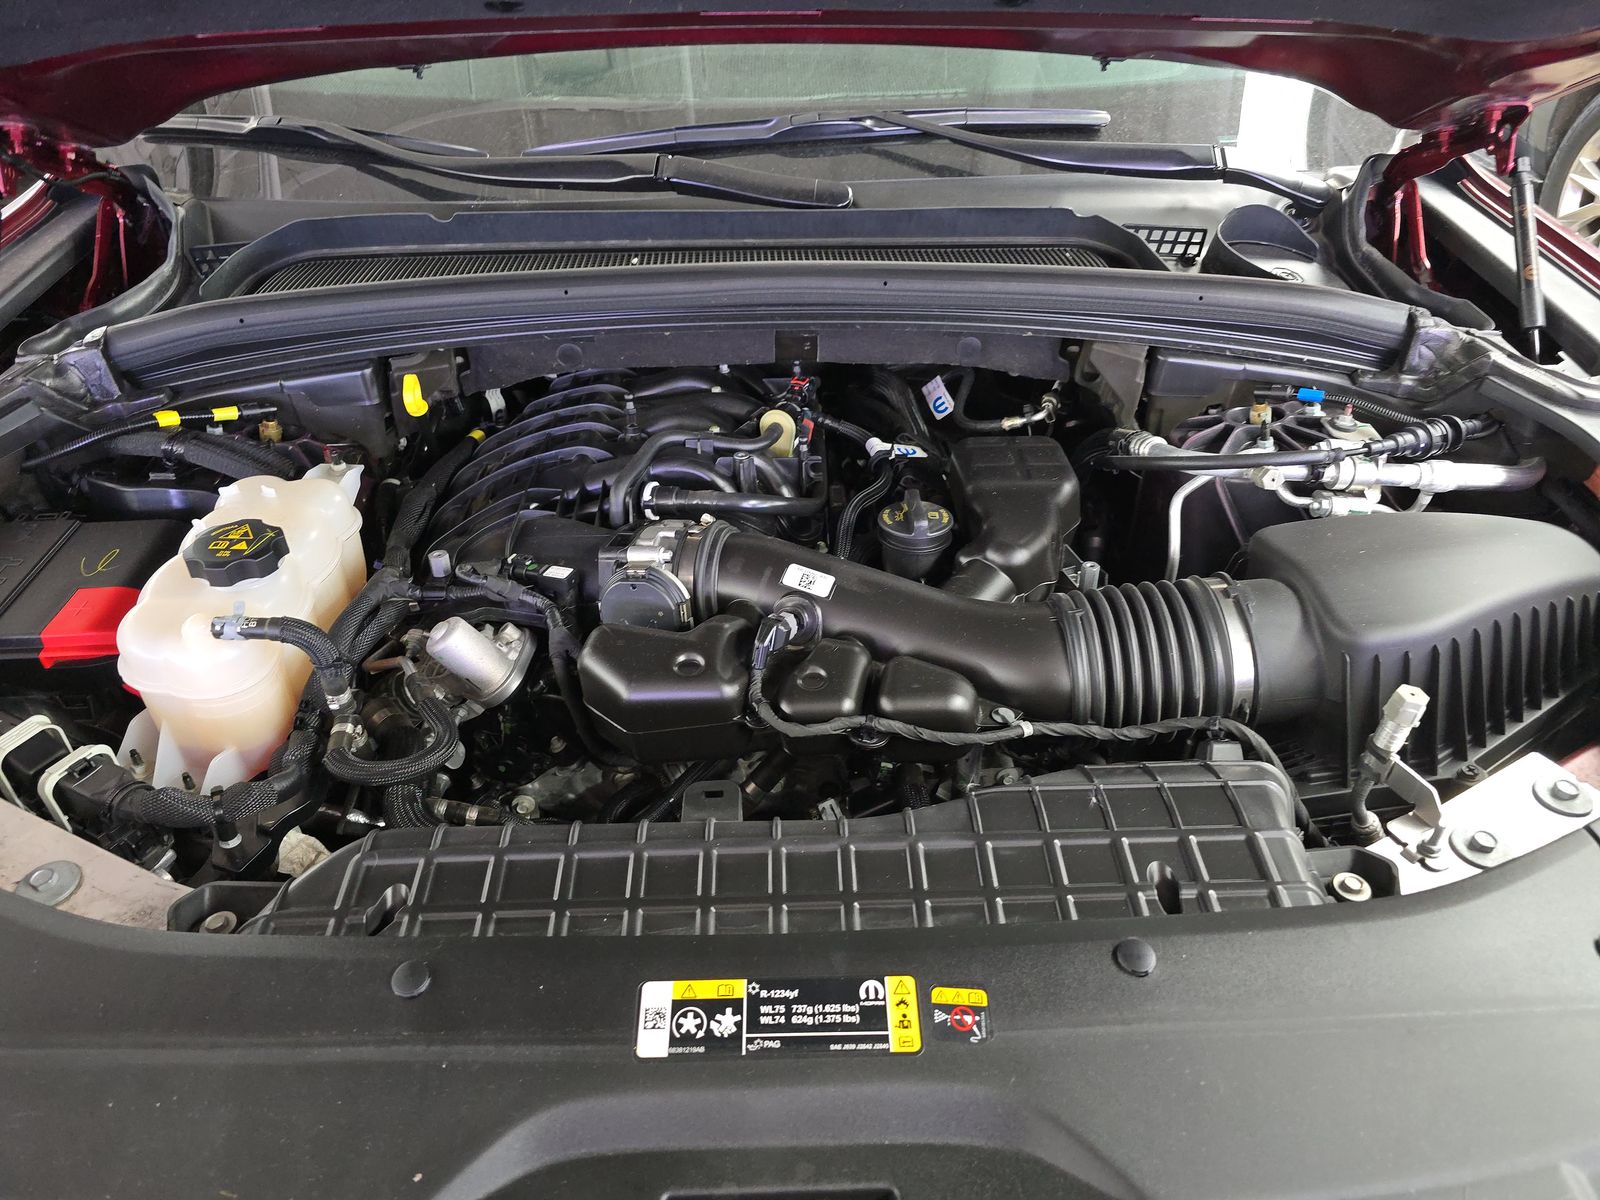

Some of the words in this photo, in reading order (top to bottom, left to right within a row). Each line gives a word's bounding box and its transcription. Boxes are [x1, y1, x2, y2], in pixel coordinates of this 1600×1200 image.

[760, 1005, 785, 1014] WL75
[791, 1004, 813, 1014] 737g
[814, 1004, 841, 1014] (1.625
[842, 1003, 860, 1013] lbs)
[760, 1015, 785, 1024] WL74
[791, 1015, 813, 1025] 624g
[814, 1015, 841, 1025] (1.375
[842, 1014, 860, 1024] lbs)
[764, 1040, 781, 1049] PAG
